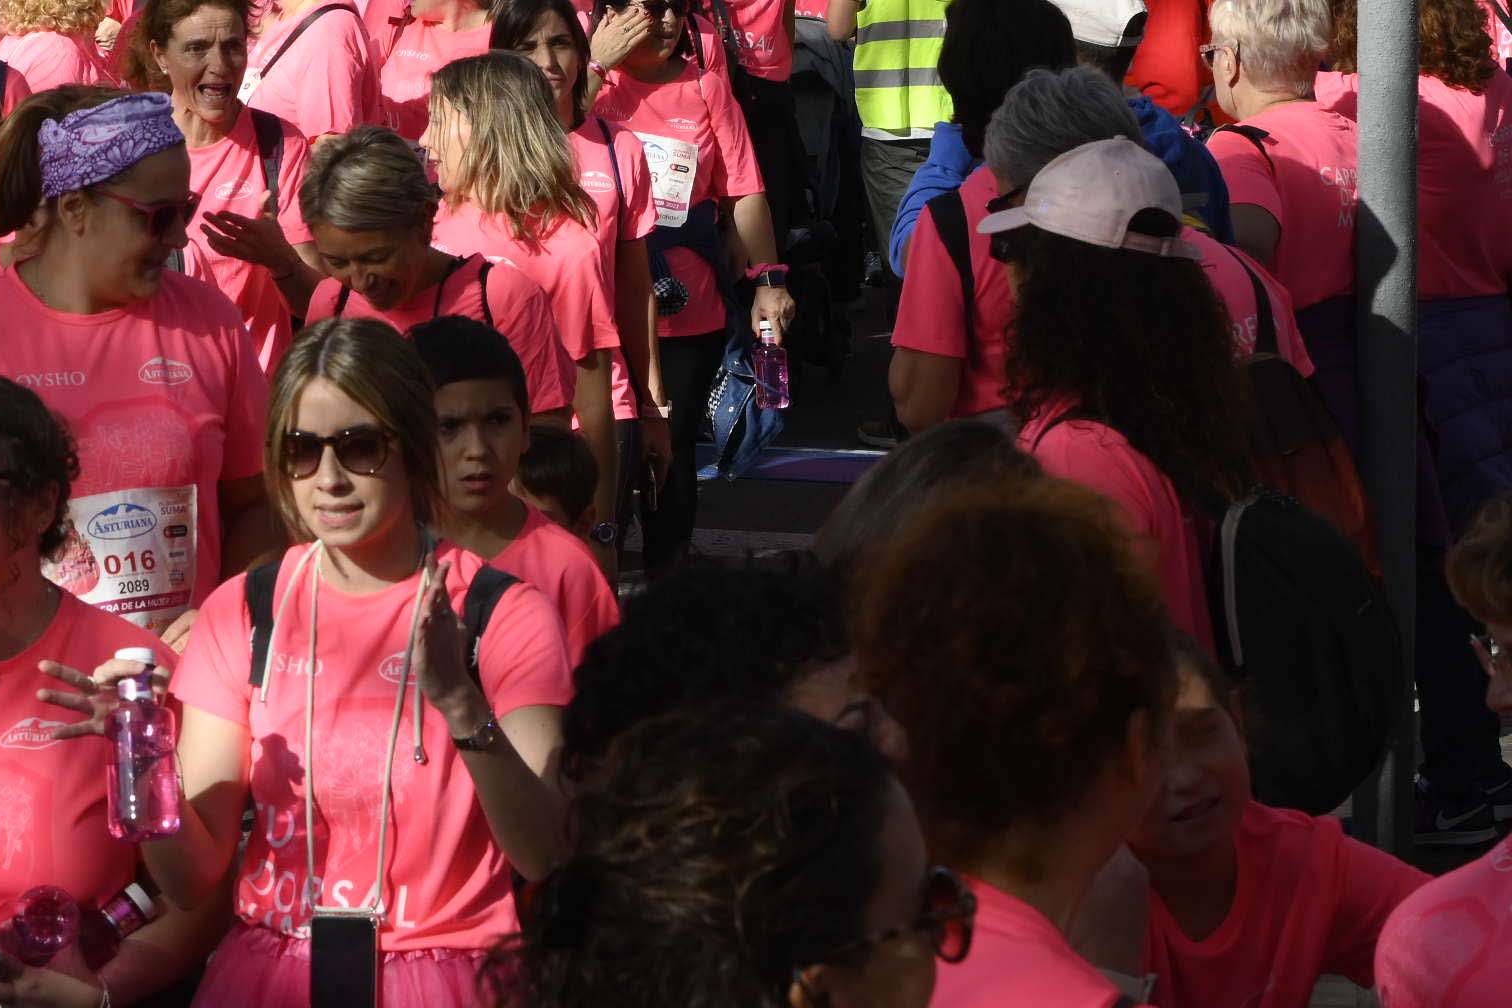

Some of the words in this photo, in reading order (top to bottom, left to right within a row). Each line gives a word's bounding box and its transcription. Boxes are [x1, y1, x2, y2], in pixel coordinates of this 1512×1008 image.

[16, 370, 86, 387] OYSHO
[161, 505, 186, 516] SUMA
[93, 517, 154, 535] ASTURIANA
[103, 549, 156, 575] 016
[118, 579, 150, 594] 2089
[121, 602, 133, 611] DE
[135, 601, 146, 609] LA
